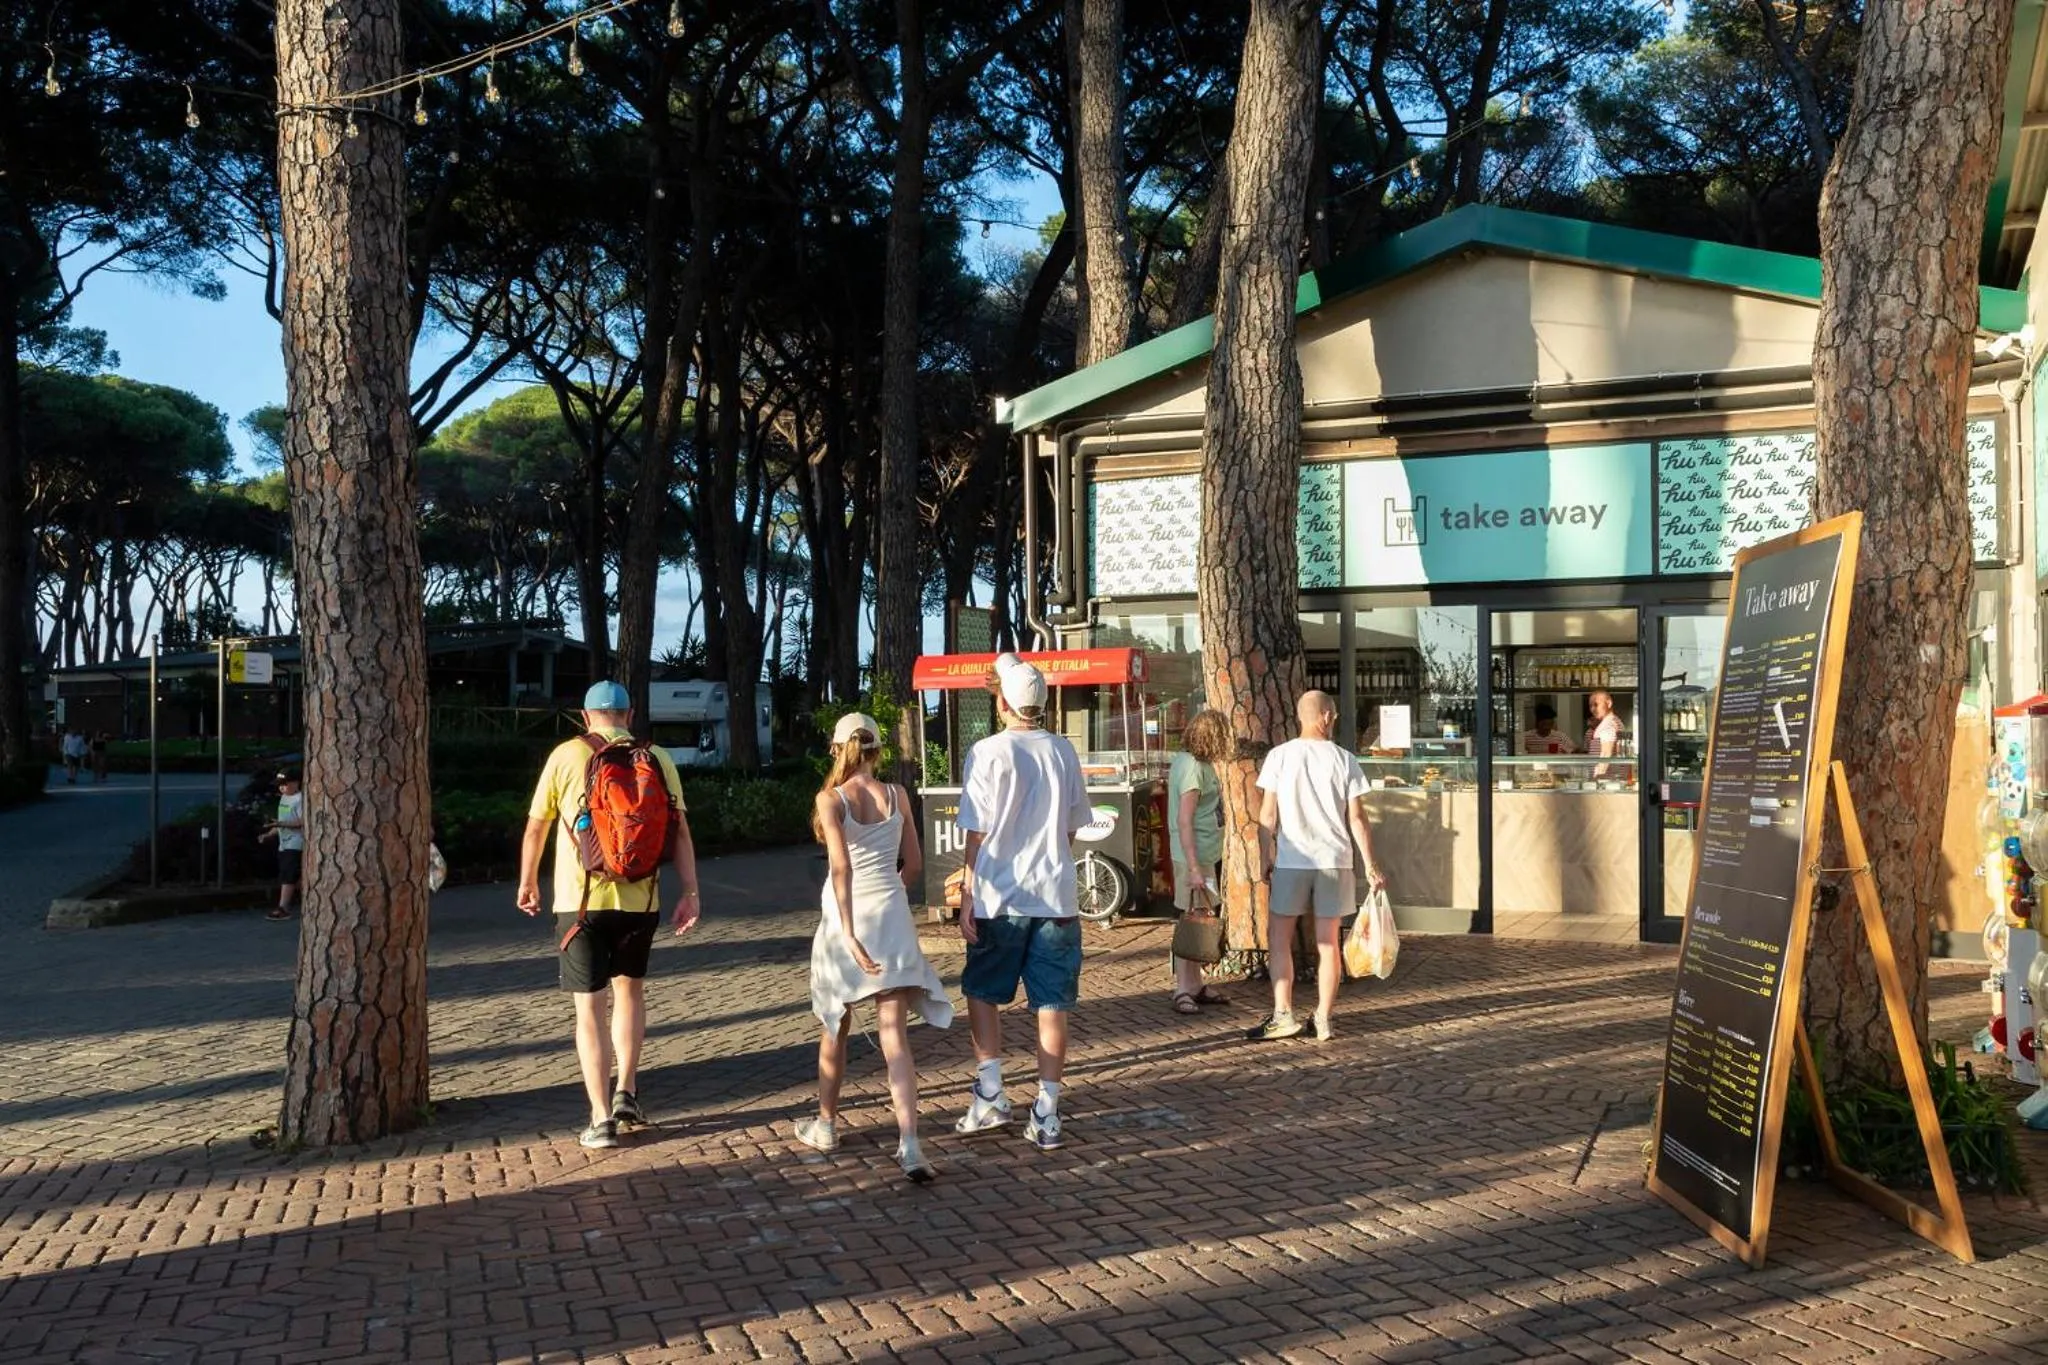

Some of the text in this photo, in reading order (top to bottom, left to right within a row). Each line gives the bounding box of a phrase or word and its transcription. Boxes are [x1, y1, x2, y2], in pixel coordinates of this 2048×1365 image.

[1662, 450, 1696, 470] hu
[1698, 452, 1722, 465] hu
[1727, 446, 1762, 466] hu
[1764, 448, 1789, 462] hu
[1688, 472, 1706, 484] hu
[1717, 469, 1737, 481] hu
[1754, 469, 1773, 481] hu
[1785, 465, 1805, 477] hu
[1304, 484, 1333, 502] hu
[1662, 476, 1815, 503] hu hu hu hu h
[1147, 495, 1174, 512] hu
[1176, 497, 1194, 509] hu
[1687, 506, 1706, 517] hu
[1717, 503, 1737, 514] hu
[1754, 502, 1774, 514] hu
[1785, 499, 1805, 511] hu
[1304, 514, 1333, 533] hu
[1440, 503, 1607, 530] take away
[1662, 516, 1696, 537] hu
[1698, 518, 1722, 532] hu
[1728, 513, 1763, 533] hu
[1766, 515, 1790, 529] hu
[1148, 524, 1174, 541] hu
[1176, 526, 1194, 538] hu
[1688, 539, 1706, 551] hu
[1717, 536, 1737, 548] hu
[1148, 553, 1174, 571] hu
[1304, 544, 1333, 563] hu
[1662, 549, 1722, 570] hu hu
[1745, 579, 1820, 617] Take away
[948, 663, 960, 675] LA
[961, 661, 995, 675] QUALIT
[935, 820, 967, 855] HO
